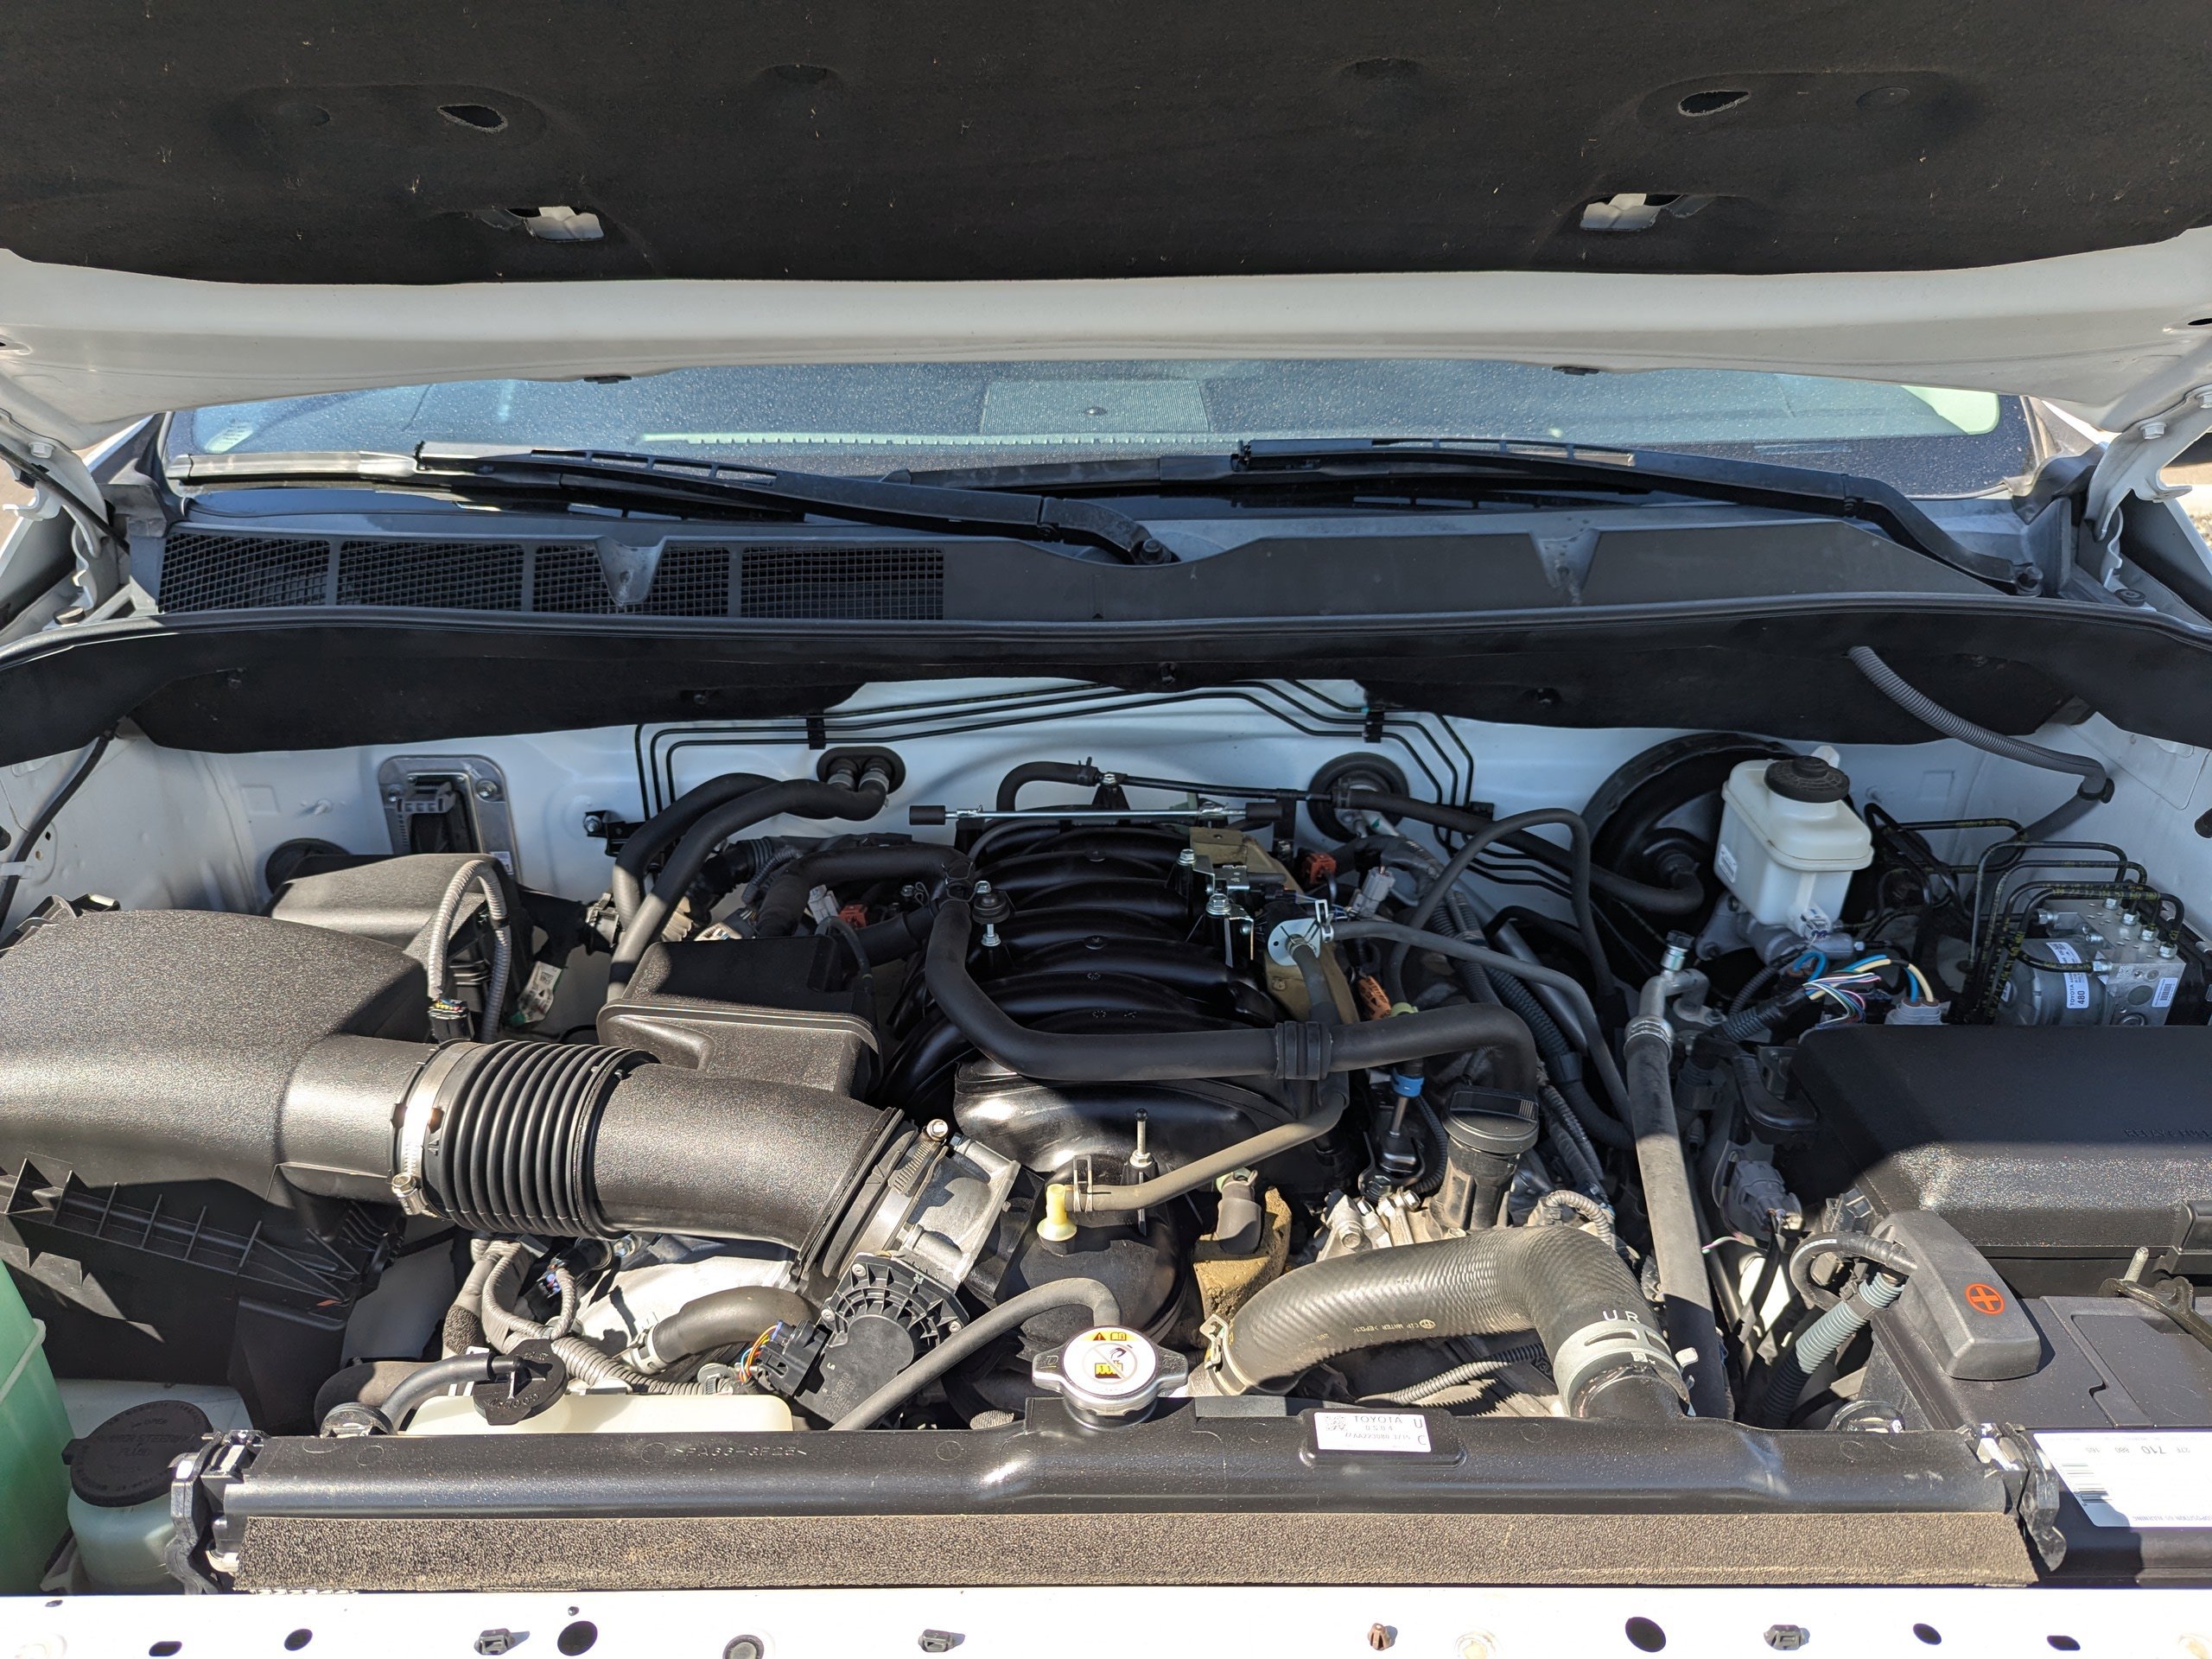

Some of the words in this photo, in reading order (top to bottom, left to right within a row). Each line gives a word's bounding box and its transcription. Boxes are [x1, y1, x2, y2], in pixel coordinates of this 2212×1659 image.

[2076, 990, 2085, 1005] 480
[1354, 1414, 1403, 1424] TOYOTA
[1414, 1418, 1423, 1428] U
[1417, 1435, 1427, 1446] C
[2140, 1446, 2167, 1454] 710
